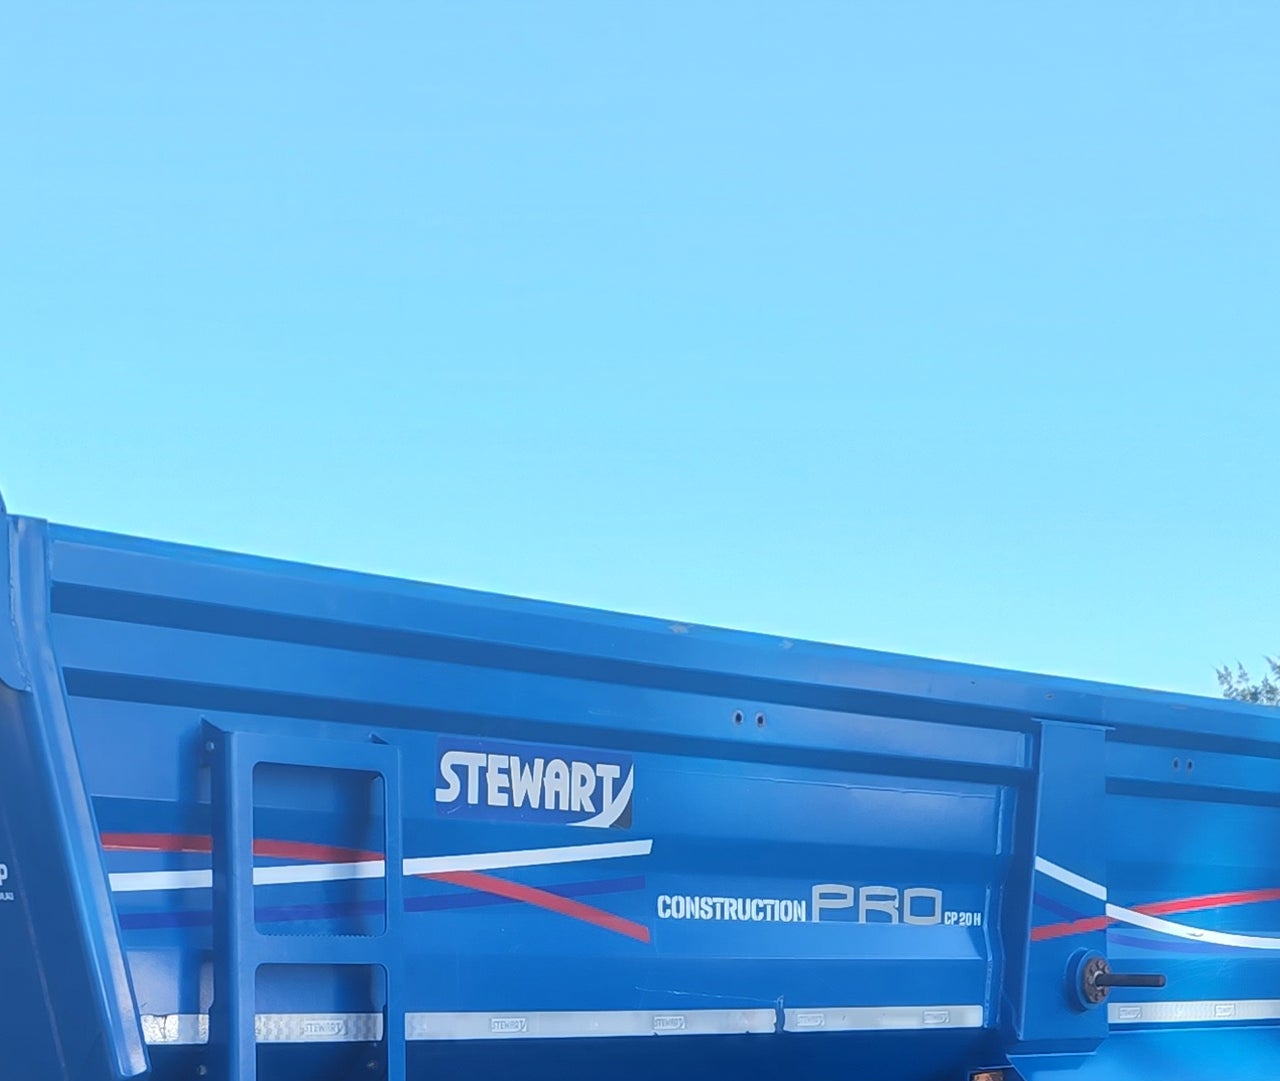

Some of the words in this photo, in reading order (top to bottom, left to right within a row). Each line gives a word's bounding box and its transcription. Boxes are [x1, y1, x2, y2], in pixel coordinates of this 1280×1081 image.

[435, 750, 634, 829] STEWART
[657, 895, 806, 922] CONSTRUCTION
[812, 884, 942, 925] PRO
[944, 911, 958, 925] CP
[959, 911, 972, 926] 20
[973, 912, 982, 926] H
